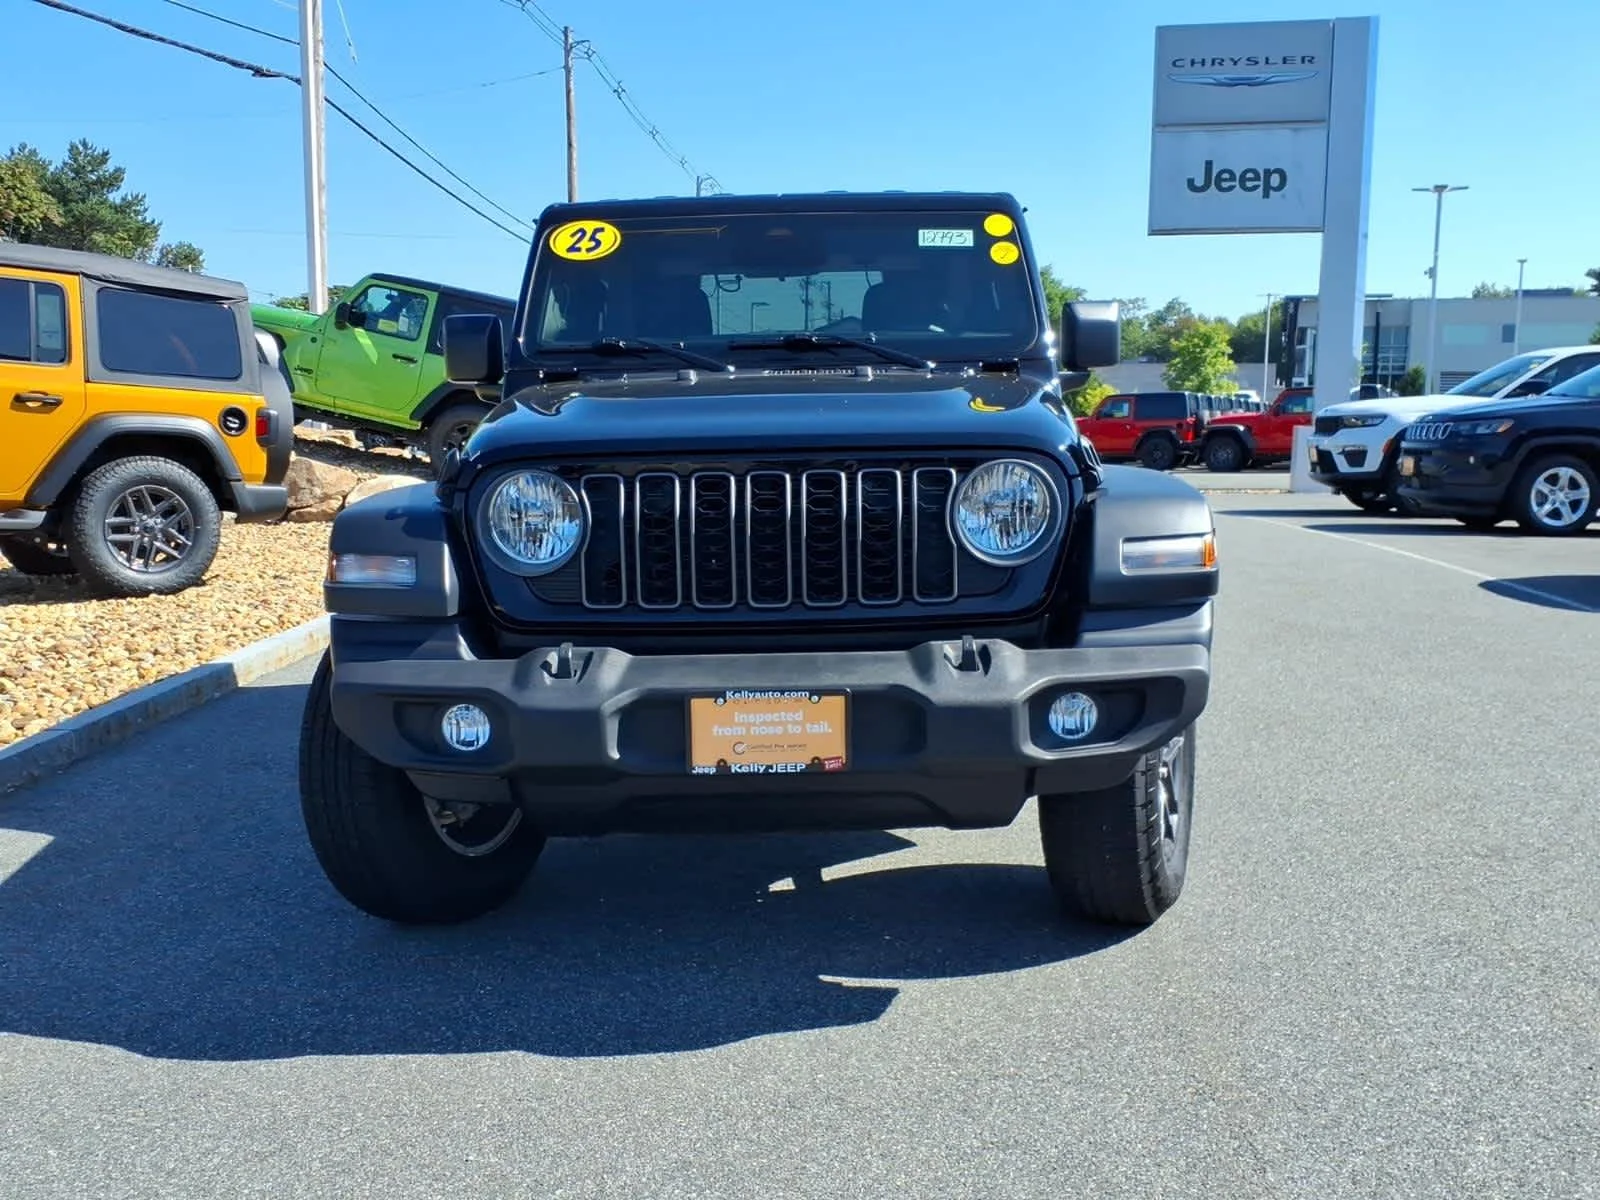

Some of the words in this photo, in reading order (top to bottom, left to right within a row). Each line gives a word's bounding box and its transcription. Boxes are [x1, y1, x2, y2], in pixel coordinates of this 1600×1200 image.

[1171, 55, 1316, 68] CHRYSLER
[1186, 160, 1288, 199] Jeep
[566, 227, 605, 253] 25
[726, 690, 810, 700] Kellyauto.com
[713, 725, 746, 736] from
[750, 725, 784, 735] nose
[787, 723, 802, 734] to
[806, 720, 832, 733] tail.
[692, 766, 717, 775] Jeep
[731, 763, 766, 774] Kelly
[769, 763, 806, 773] JEEP
